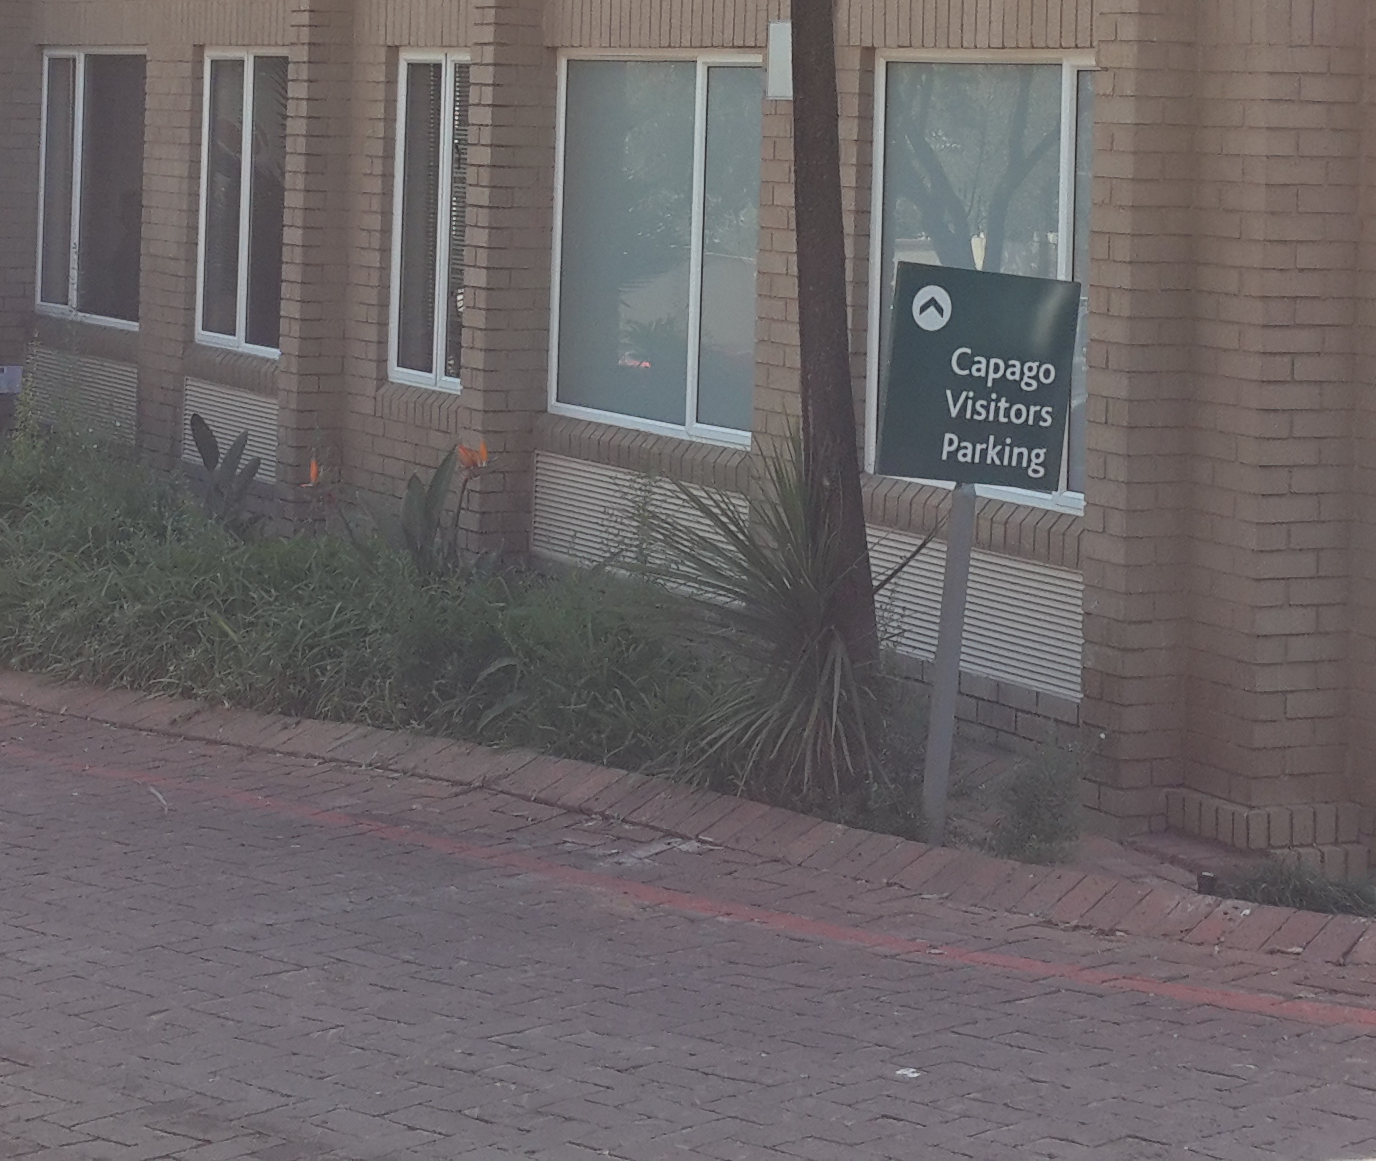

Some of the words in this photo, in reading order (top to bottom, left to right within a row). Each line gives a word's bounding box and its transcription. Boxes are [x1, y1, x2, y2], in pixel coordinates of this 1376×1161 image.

[950, 346, 1056, 392] Capago
[945, 388, 1054, 428] Visitors
[940, 432, 1048, 479] Parking
